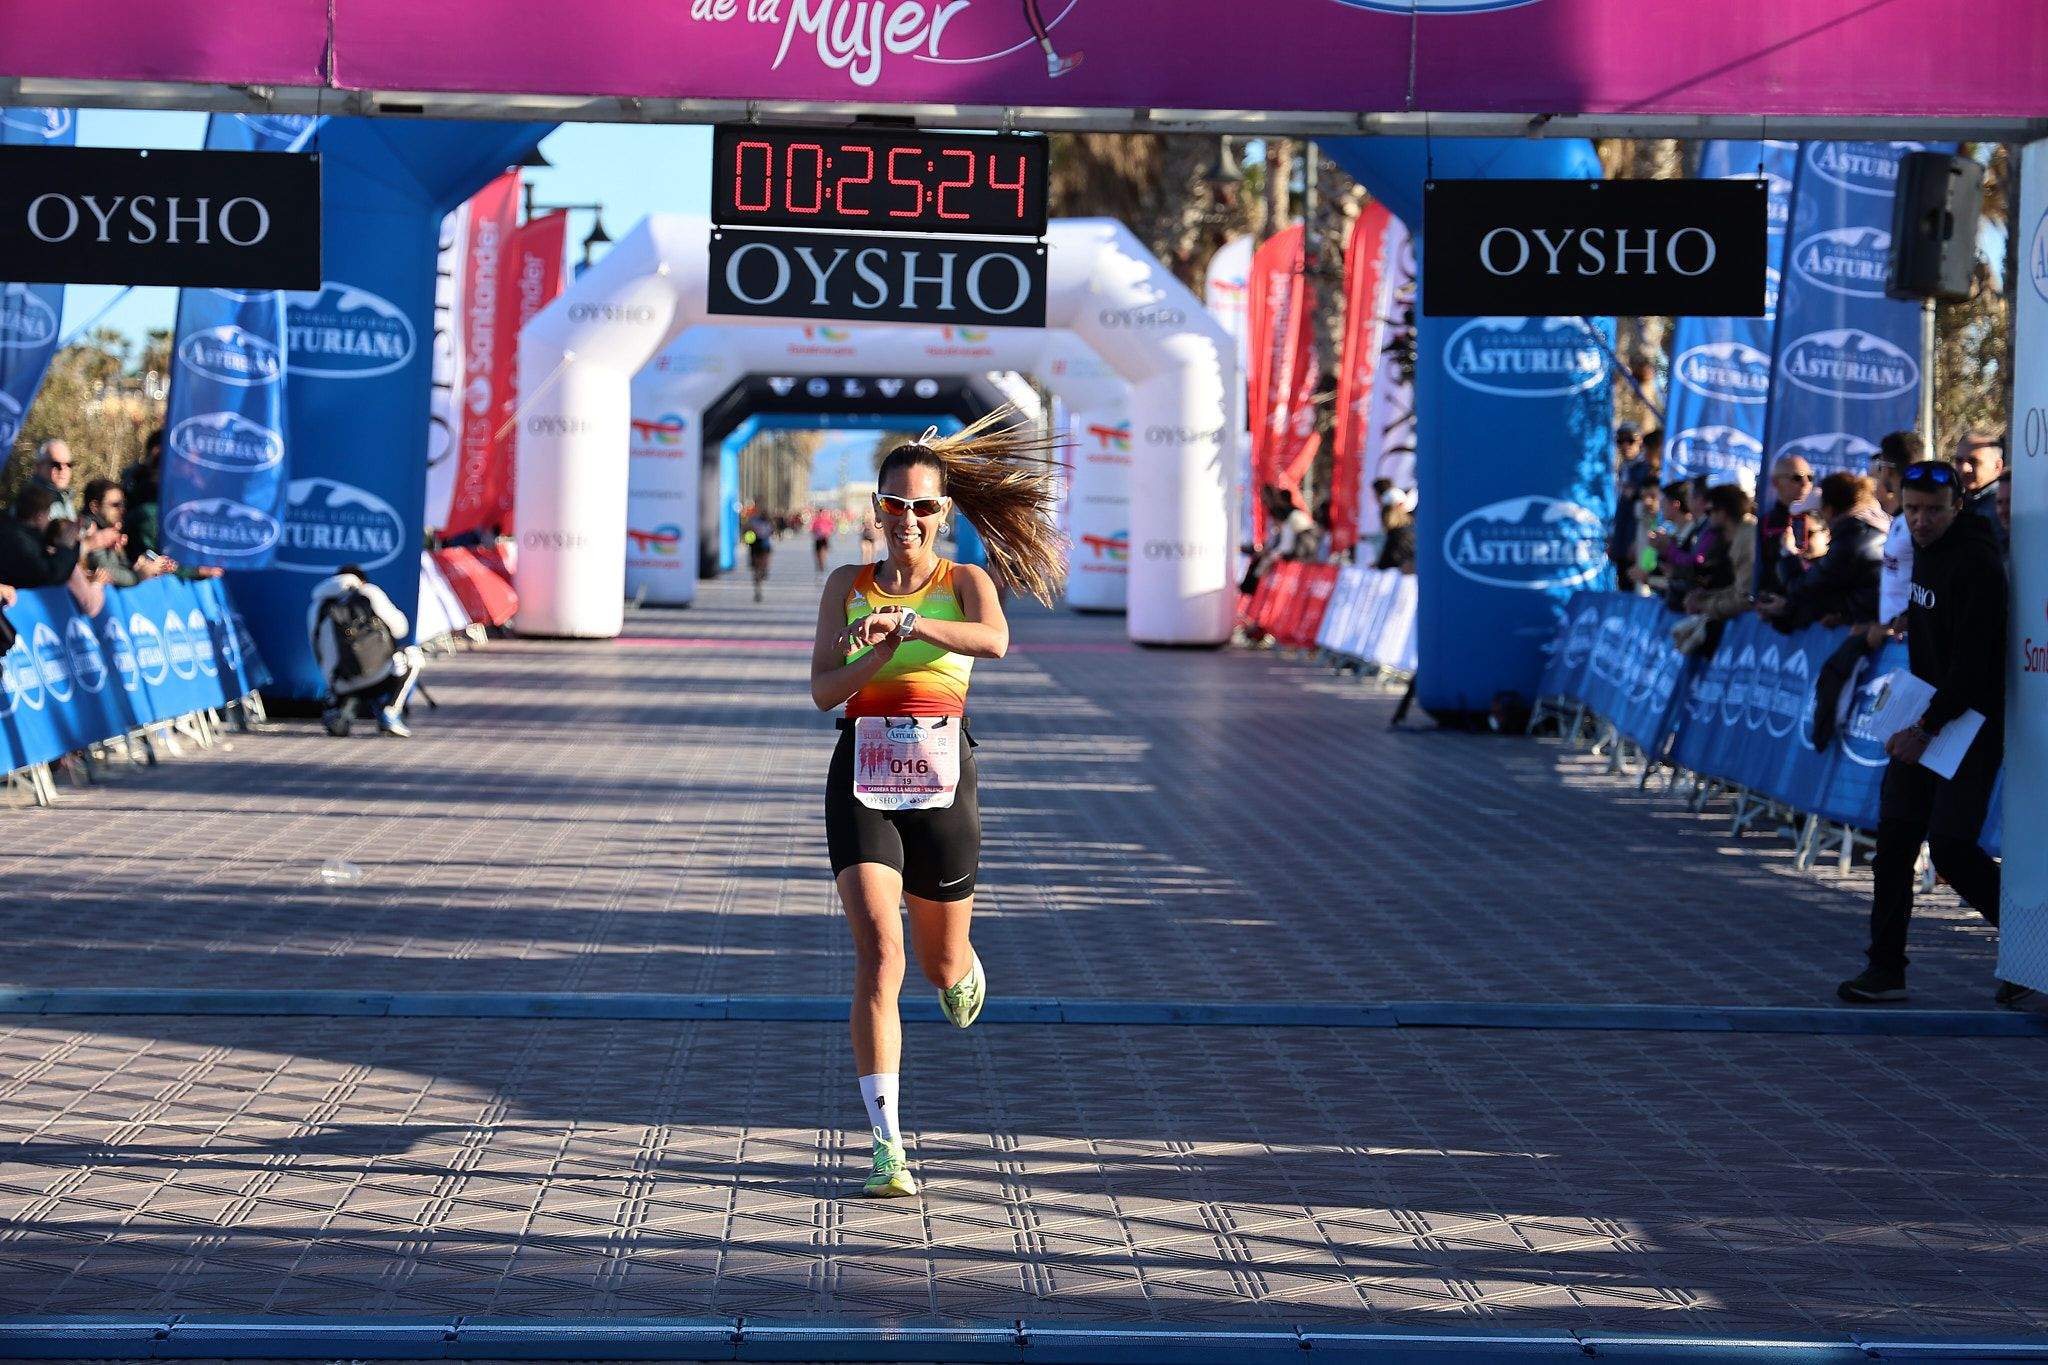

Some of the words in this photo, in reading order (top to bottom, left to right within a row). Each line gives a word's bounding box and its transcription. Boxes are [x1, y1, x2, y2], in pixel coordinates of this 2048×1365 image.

[690, 0, 738, 21] de
[770, 0, 971, 86] Mujer
[735, 141, 1026, 218] 00:25:24
[27, 192, 271, 247] OYSHO
[1478, 226, 1718, 277] OYSHO
[465, 217, 501, 375] Santander
[725, 242, 1031, 315] OYSHO
[1791, 346, 1906, 386] ASTURIANA
[890, 759, 929, 774] 016
